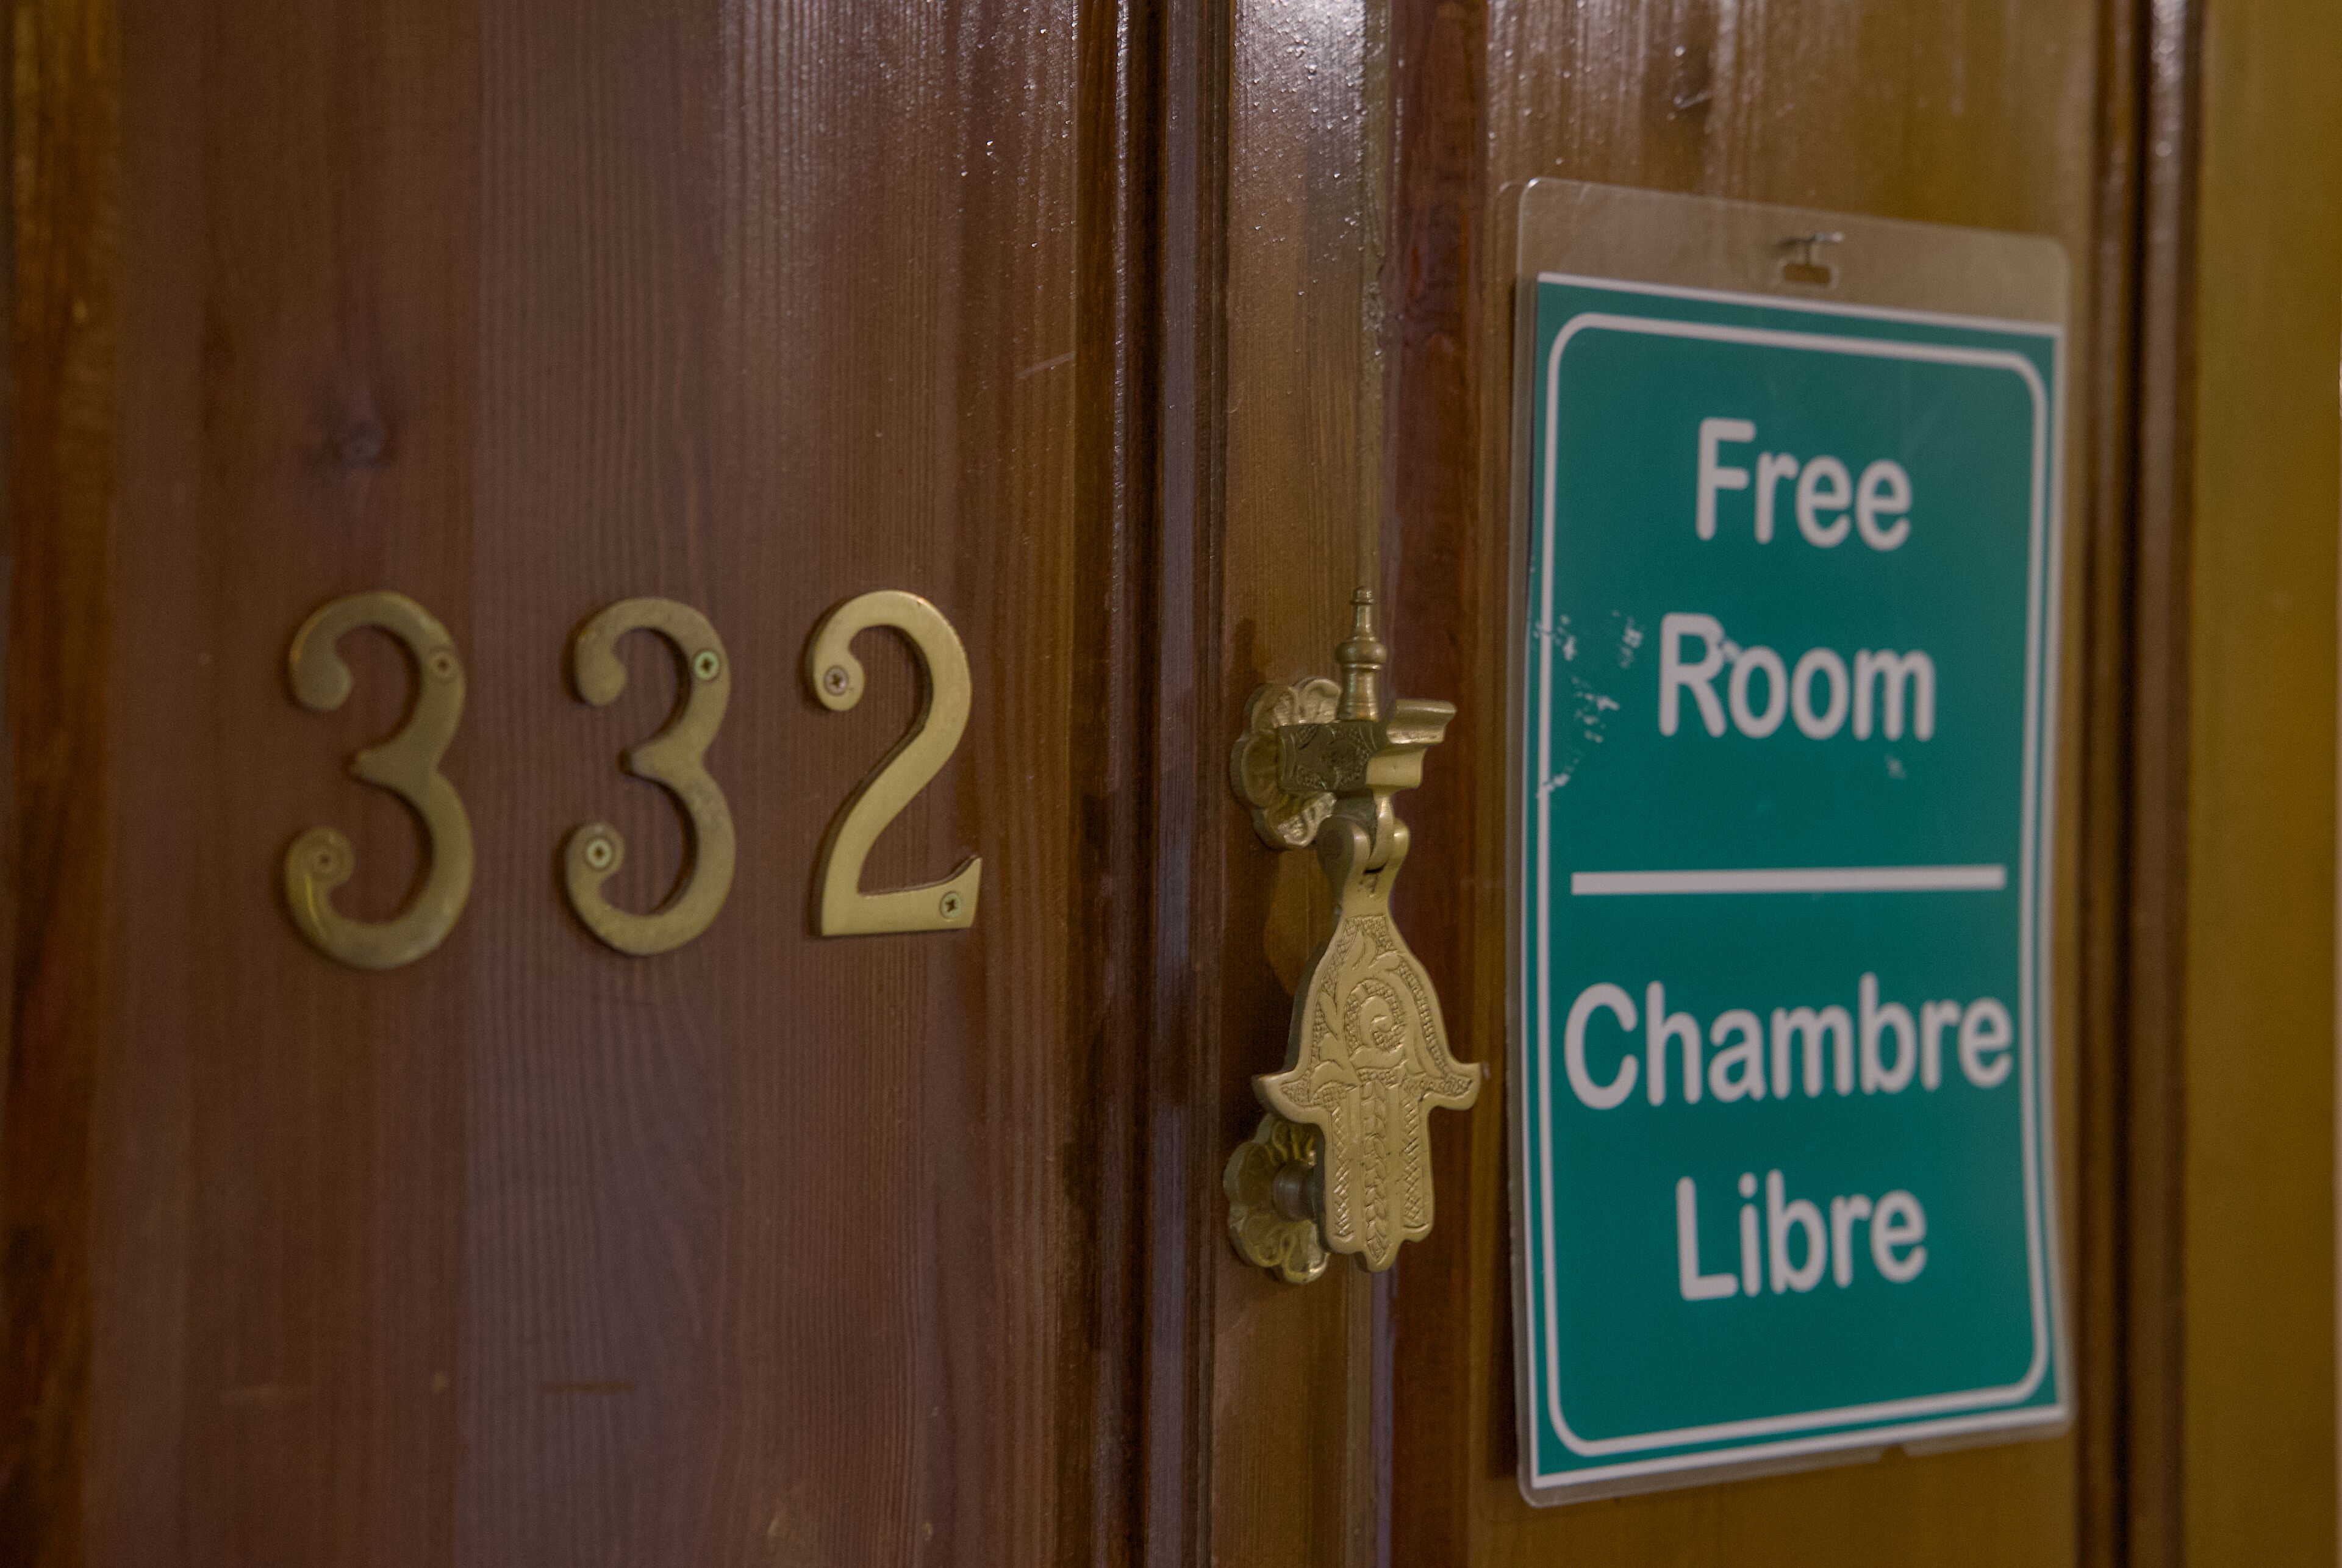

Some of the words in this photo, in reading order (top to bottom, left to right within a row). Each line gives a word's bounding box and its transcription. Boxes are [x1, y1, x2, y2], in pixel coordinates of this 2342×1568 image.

[1695, 418, 1913, 551] Free
[1658, 612, 1936, 742] Room
[284, 589, 983, 970] 332
[1563, 971, 2013, 1110] Chambre
[1675, 1169, 1927, 1301] Libre
